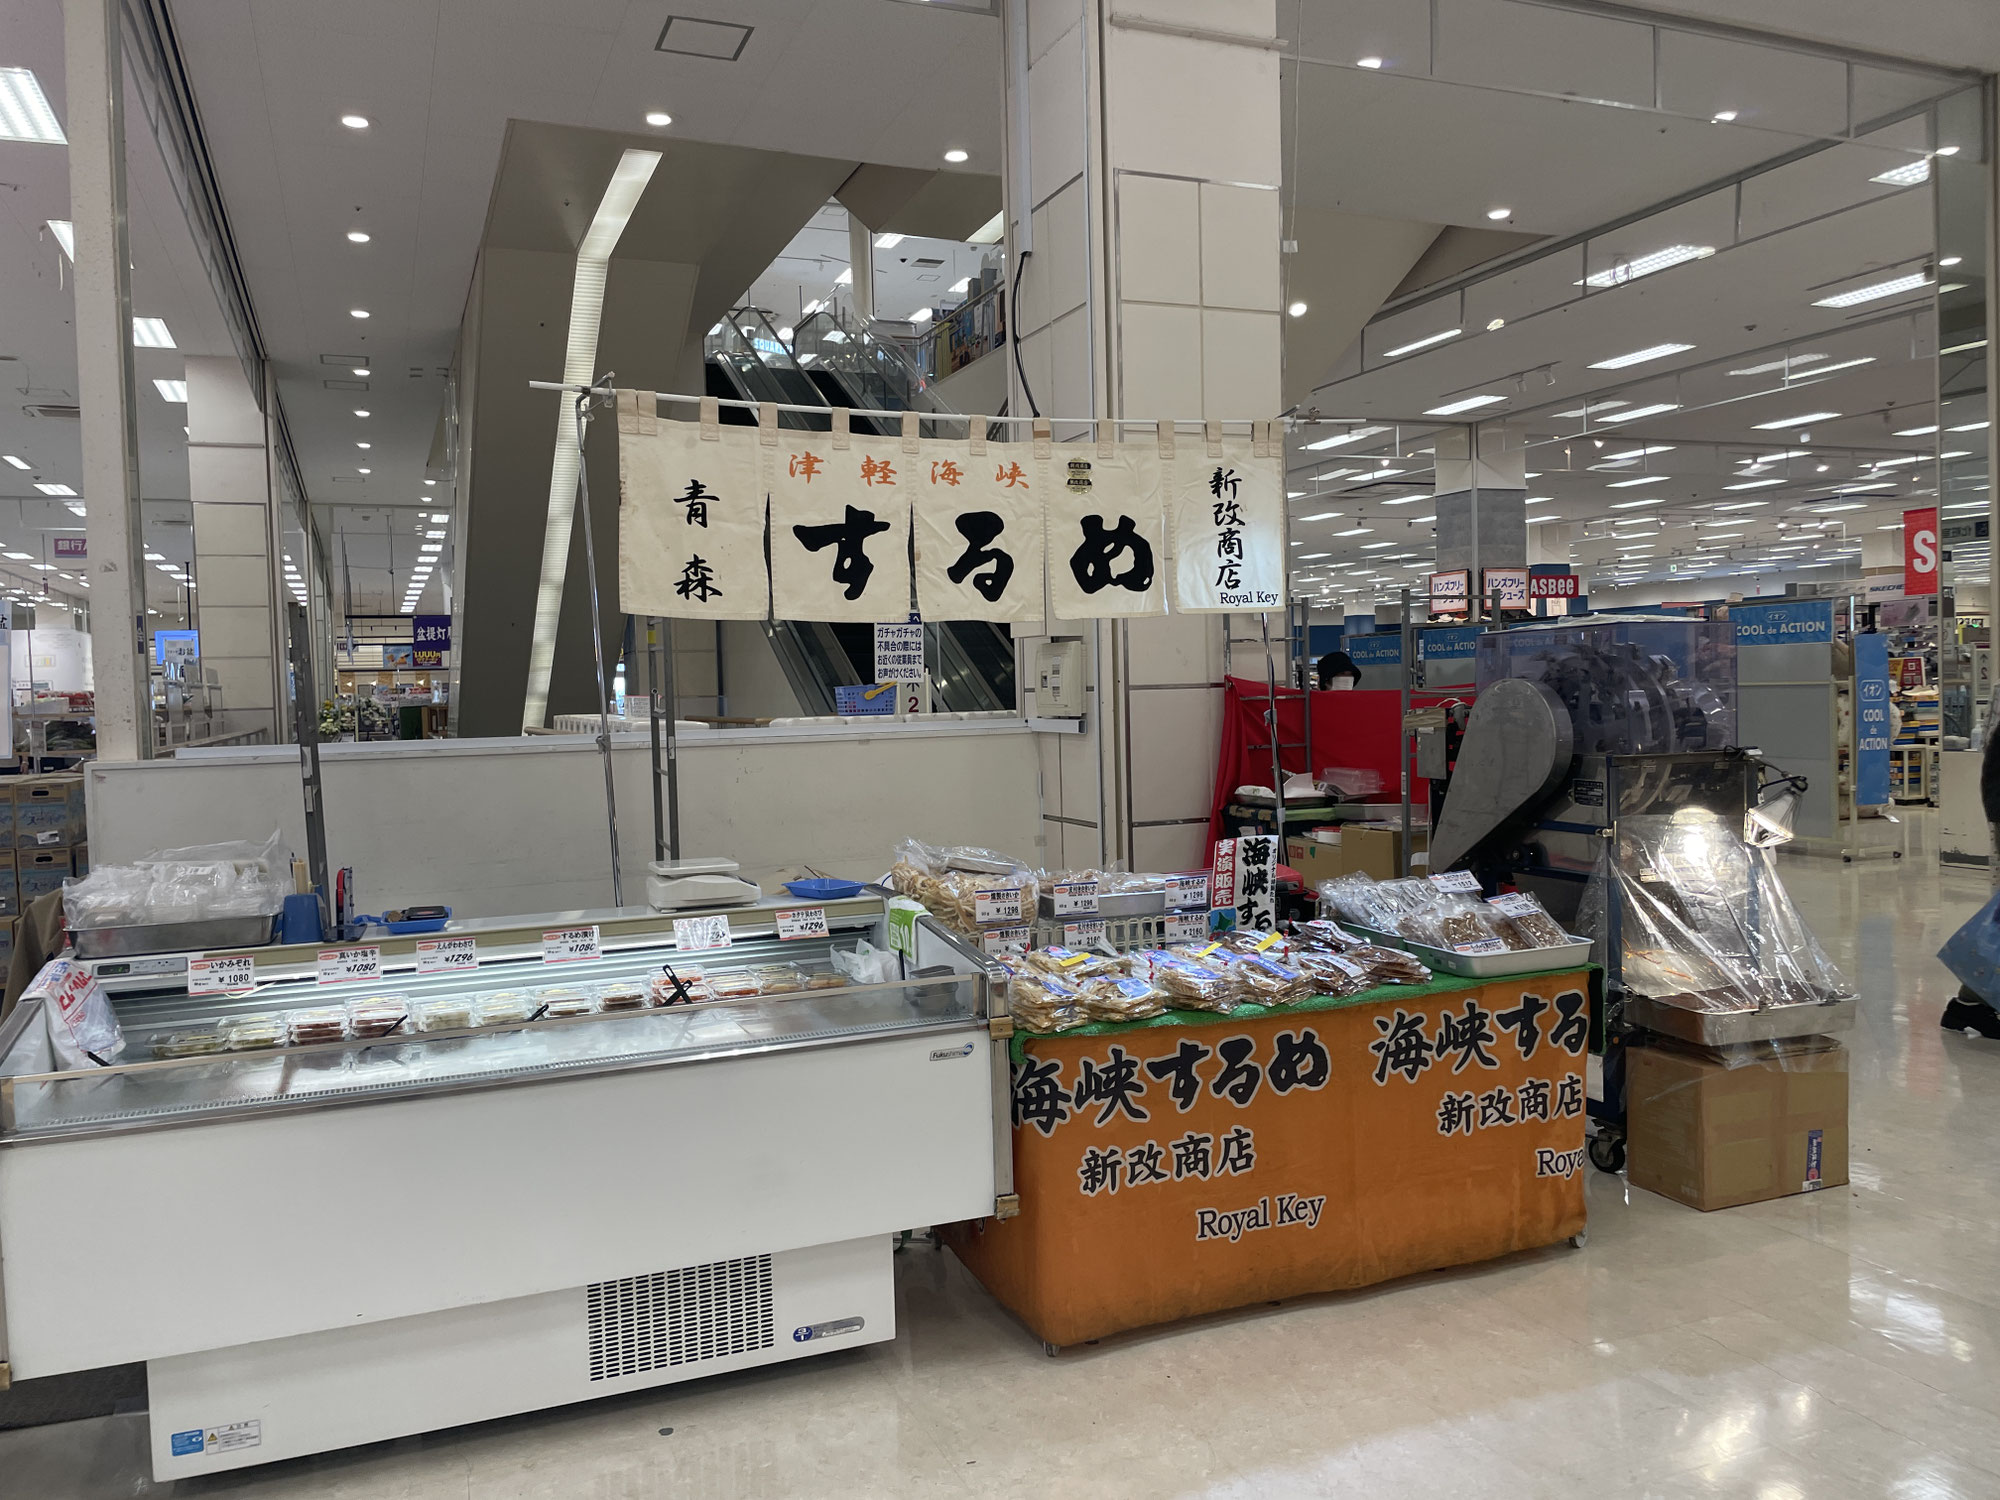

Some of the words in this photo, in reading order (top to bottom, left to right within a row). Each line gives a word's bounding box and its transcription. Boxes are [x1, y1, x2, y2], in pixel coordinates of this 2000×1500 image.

[789, 451, 1030, 490] 津軽海峡
[1208, 467, 1246, 590] 新改商店
[57, 540, 87, 552] 銀行
[674, 479, 723, 603] 青森
[792, 504, 1154, 602] するめ
[1433, 581, 1463, 593] ハンズフリー
[1488, 578, 1525, 588] ハンズフリー
[1530, 578, 1574, 595] ASBee
[1220, 591, 1253, 606] Royal
[1256, 591, 1279, 606] Key
[877, 627, 922, 638] ガチャガチャの
[1737, 625, 1765, 636] COOL
[1767, 626, 1777, 634] de
[1780, 621, 1825, 634] ACTION
[877, 641, 922, 652] 不具合の際には
[1427, 642, 1445, 652] COOL
[877, 654, 922, 666] お近くの従業員まで
[1352, 650, 1369, 659] COOL
[1375, 649, 1399, 658] ACTION
[877, 667, 922, 679] お声がけください。
[1863, 683, 1882, 697] イオン
[908, 696, 919, 713] 2
[1863, 708, 1884, 722] COOL
[1870, 725, 1877, 734] de
[1859, 737, 1888, 751] ACTION
[1215, 839, 1235, 906] 実演販売
[1237, 837, 1272, 931] 海峡する
[339, 949, 377, 960] 真いか塩辛
[210, 958, 252, 969] いかみぞれ
[1372, 992, 1588, 1083] 海峡する
[1012, 1031, 1329, 1135] 海峡するめ
[1438, 1075, 1582, 1134] 新改商店
[1079, 1128, 1255, 1194] 新改商店
[1197, 1199, 1270, 1241] Royal
[1276, 1195, 1325, 1228] Key
